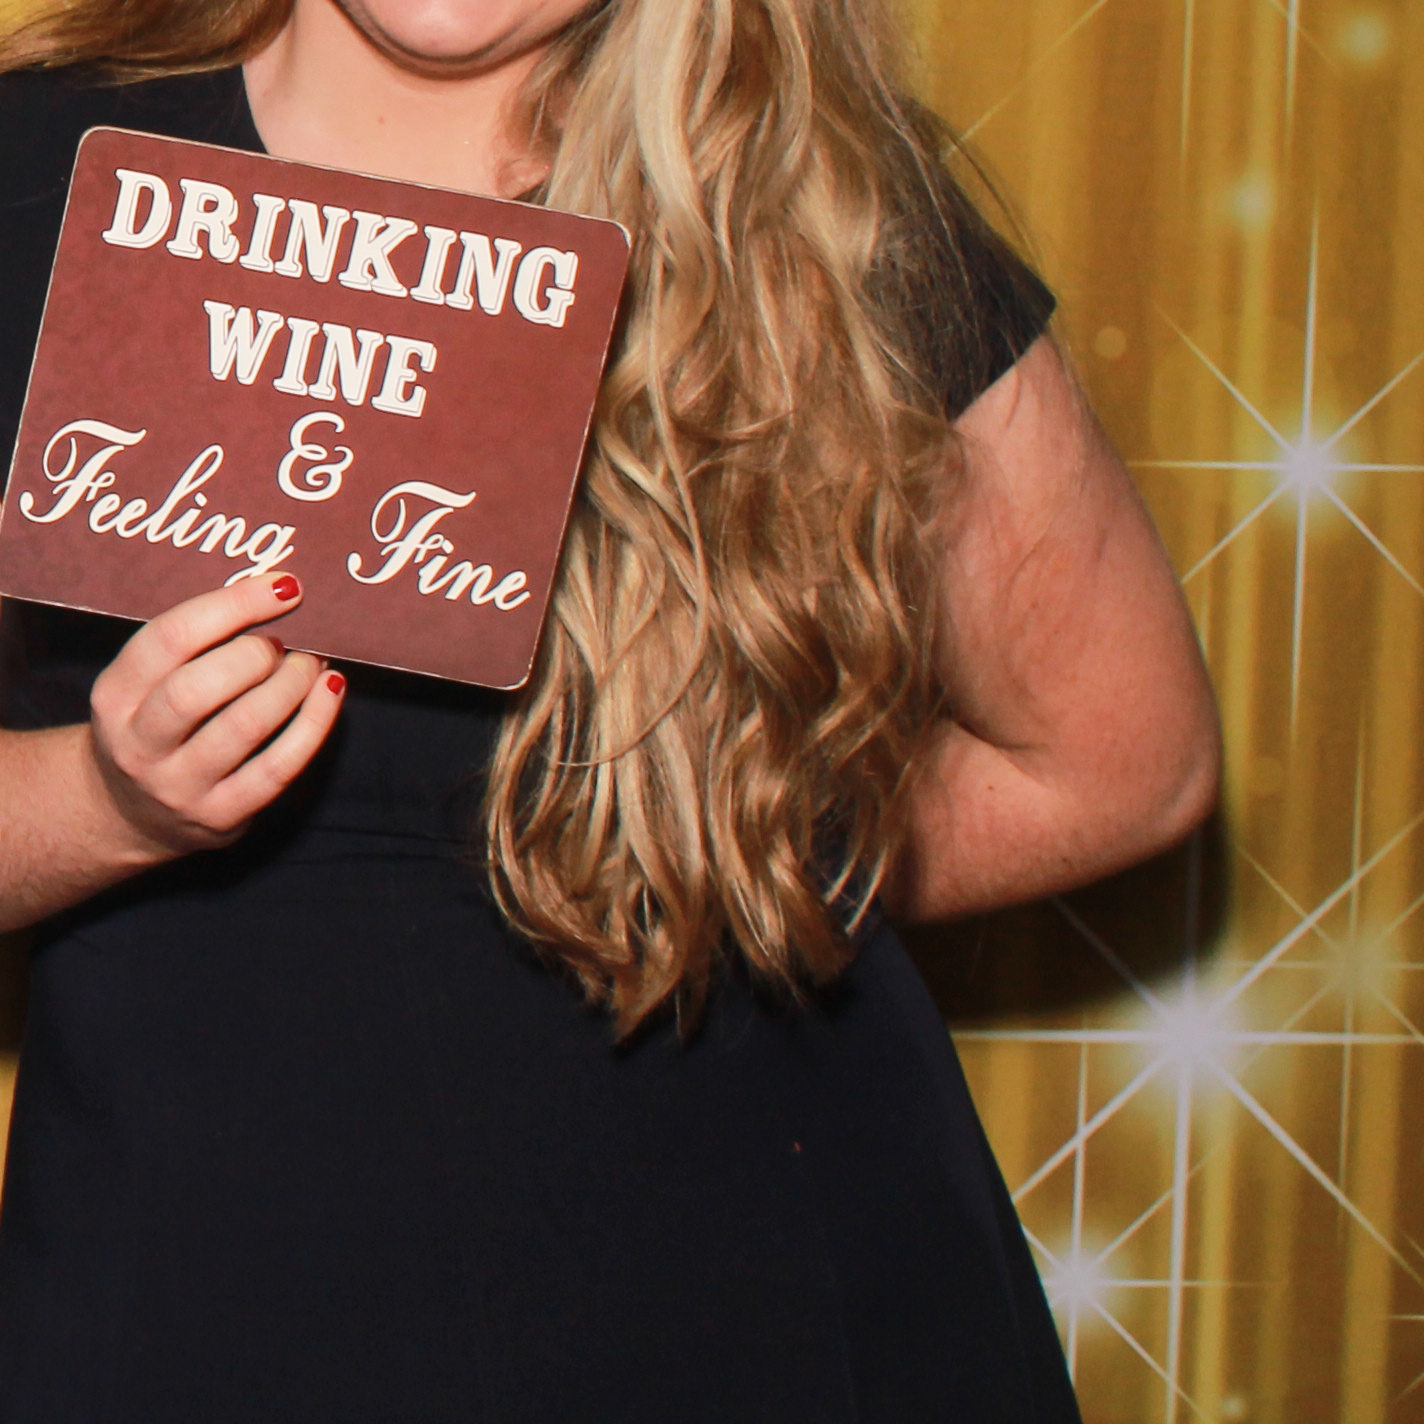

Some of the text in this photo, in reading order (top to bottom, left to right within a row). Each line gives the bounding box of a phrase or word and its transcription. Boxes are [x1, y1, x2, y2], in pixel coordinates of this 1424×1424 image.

[102, 168, 579, 328] DRINKING
[203, 299, 437, 418] WINE
[19, 418, 531, 611] Feeling Fine
[277, 411, 353, 501] &
